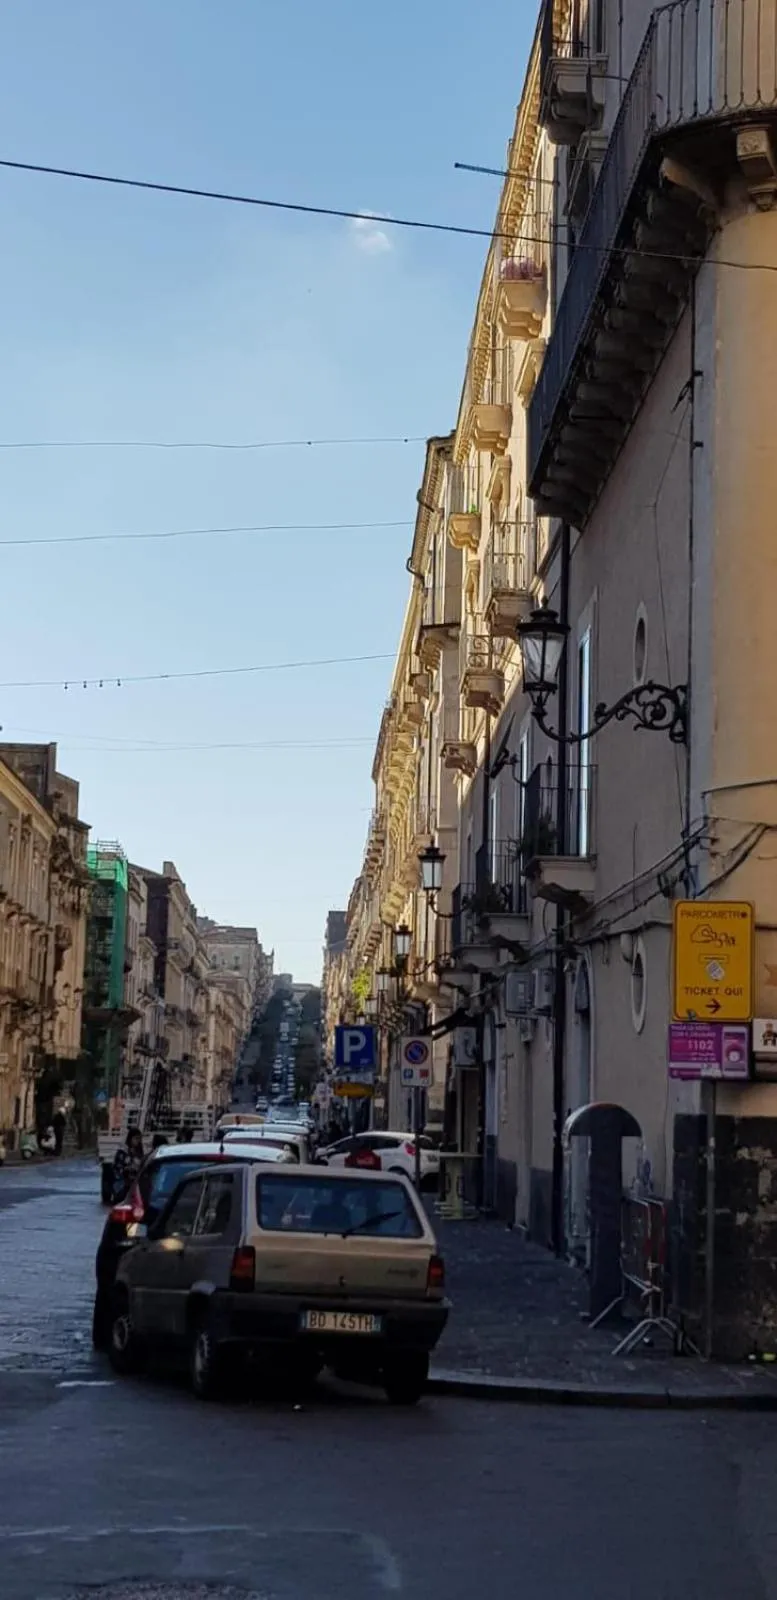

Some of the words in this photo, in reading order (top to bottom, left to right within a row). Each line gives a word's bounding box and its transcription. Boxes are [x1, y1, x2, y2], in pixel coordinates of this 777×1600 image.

[684, 987, 720, 996] TICKET
[724, 987, 743, 996] QUI
[343, 1030, 366, 1063] P
[687, 1039, 714, 1051] 1102
